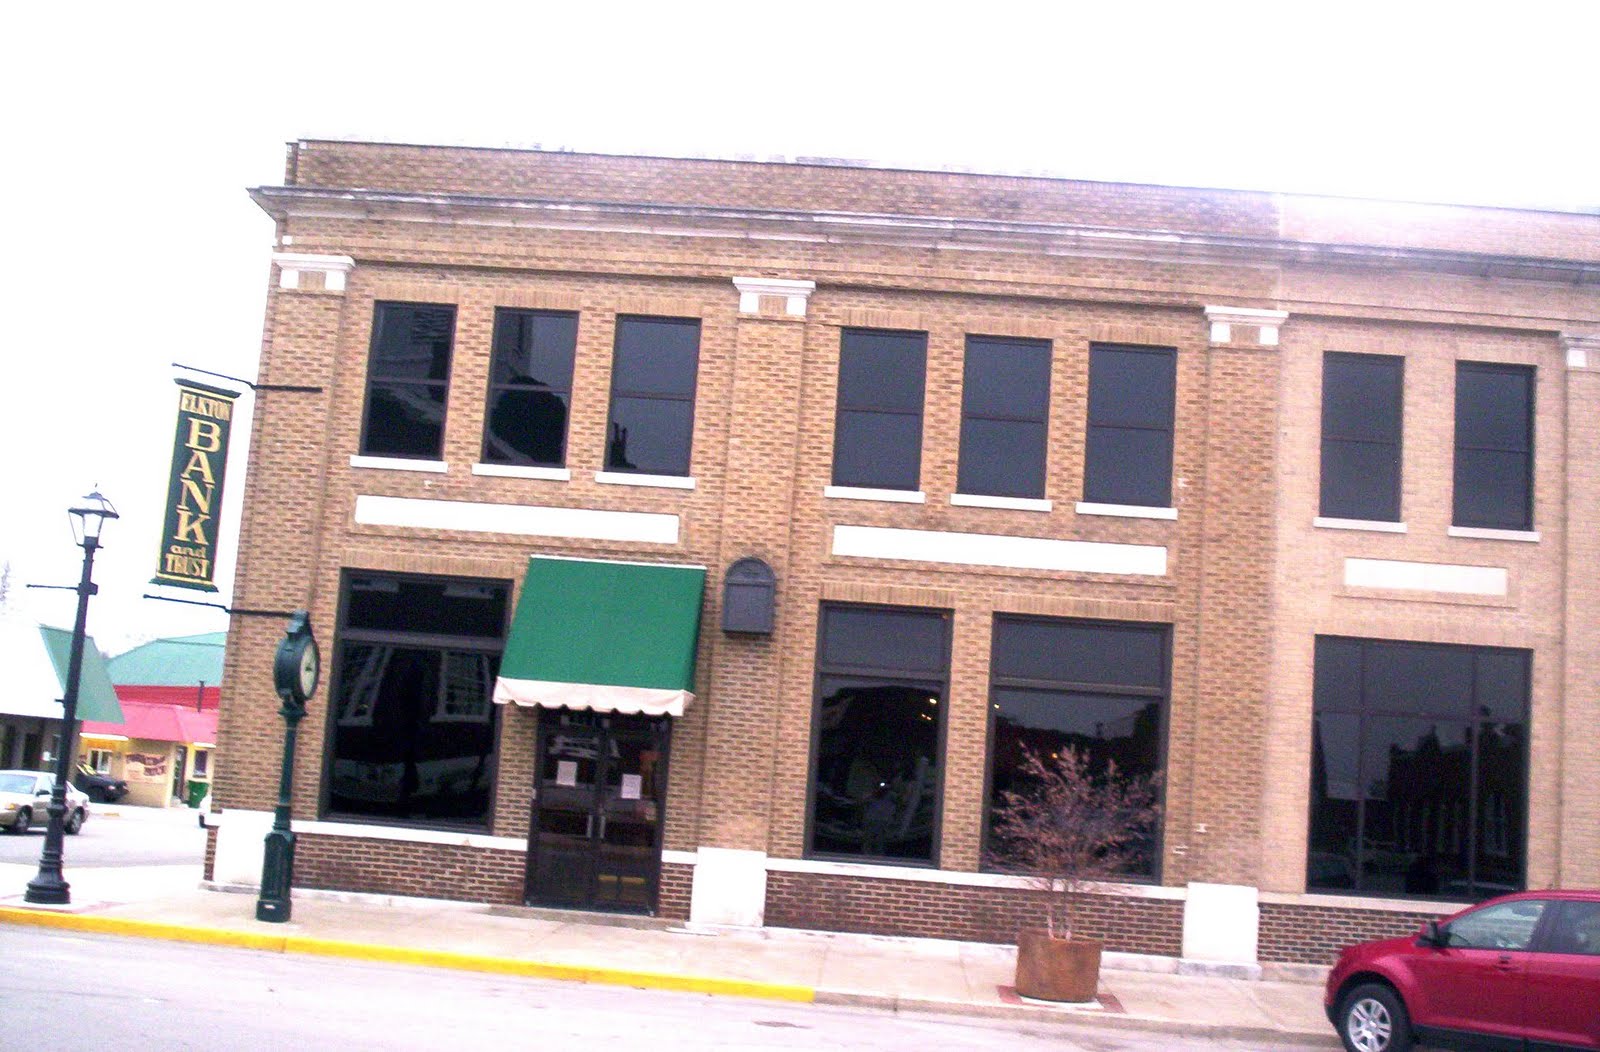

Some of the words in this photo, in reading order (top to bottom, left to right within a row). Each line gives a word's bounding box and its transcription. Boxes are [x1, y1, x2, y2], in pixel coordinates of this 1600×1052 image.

[173, 417, 221, 545] BANK
[170, 544, 206, 558] and
[166, 553, 209, 578] TRUST
